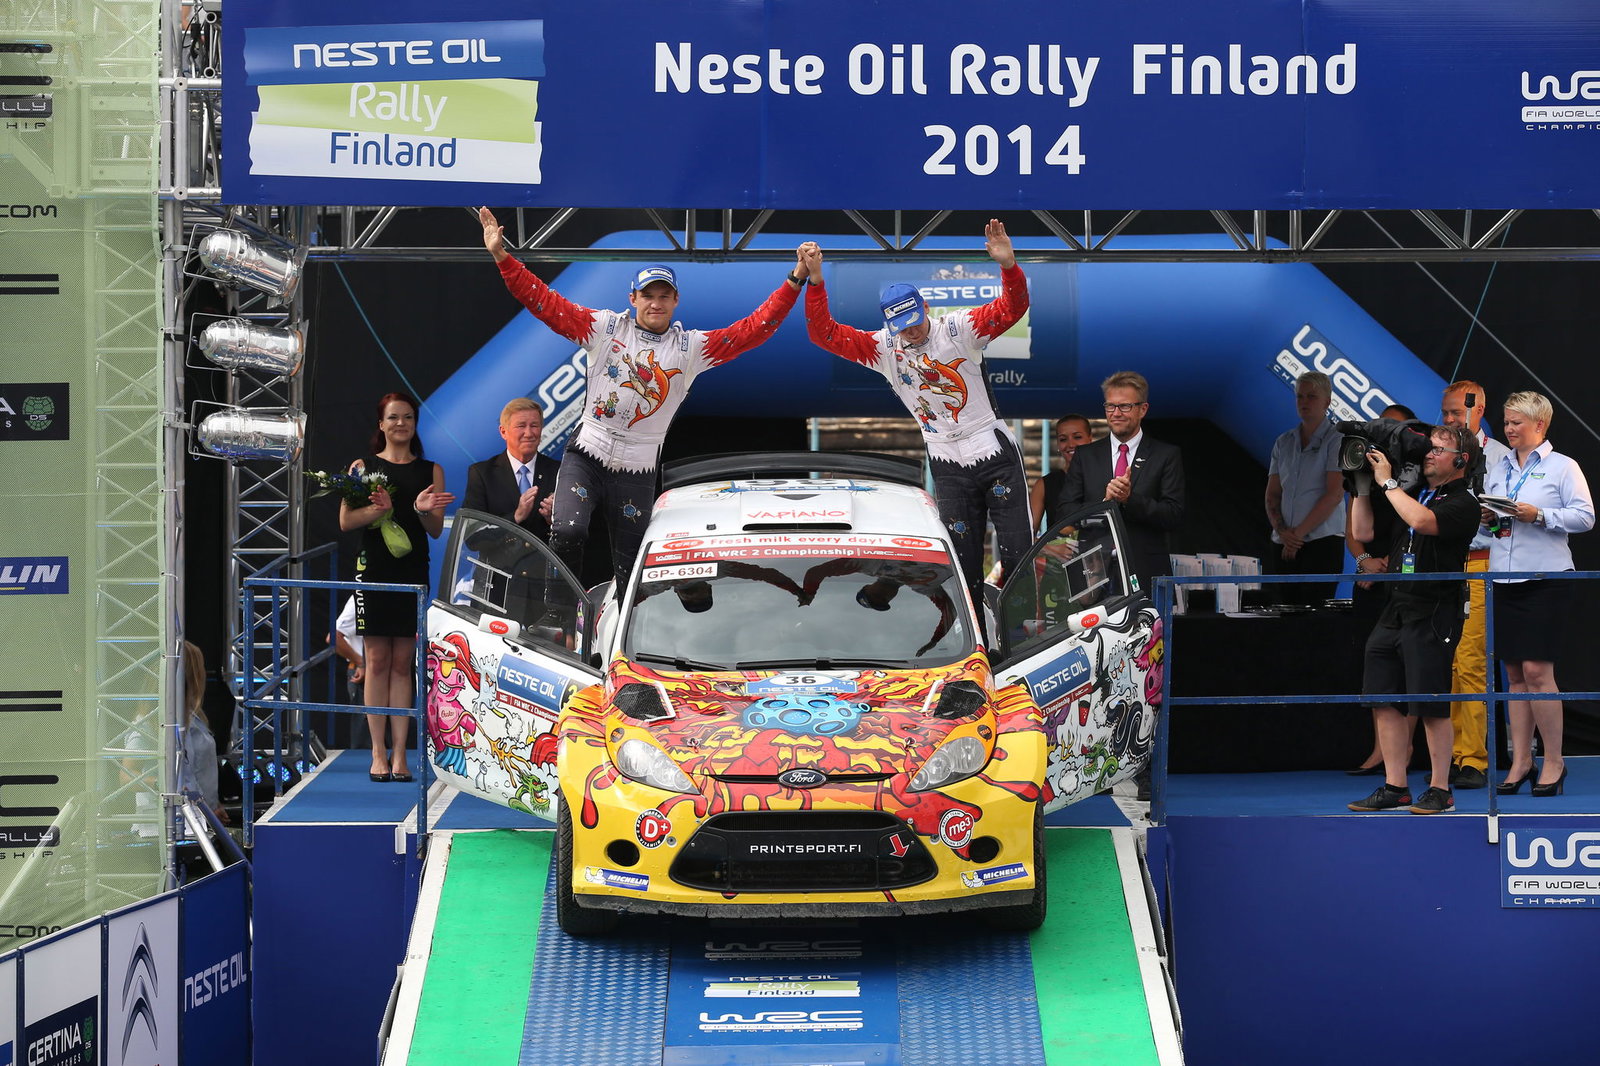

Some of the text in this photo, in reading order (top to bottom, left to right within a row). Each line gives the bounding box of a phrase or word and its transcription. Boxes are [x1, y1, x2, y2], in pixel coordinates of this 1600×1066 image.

[293, 38, 502, 68] NESTE OIL
[654, 41, 1357, 108] Neste Oil Rally Finland
[349, 82, 448, 132] Rally
[1526, 110, 1548, 118] FIA
[329, 131, 457, 168] Finland
[922, 123, 1087, 176] 2014
[710, 537, 752, 545] Fresh
[798, 536, 841, 544] every
[848, 536, 882, 545] day!
[694, 551, 715, 559] FIA
[718, 549, 749, 557] WRC
[751, 548, 760, 556] 2
[763, 548, 855, 557] Championship
[499, 665, 557, 700] NESTE OIL
[785, 675, 817, 685] 36
[1033, 660, 1088, 698] NESTE OIL
[790, 771, 816, 783] Ford
[749, 844, 862, 854] PRINTSPORT.FI
[983, 866, 1025, 880] MICHELIN
[608, 874, 649, 886] MICHELIN
[1513, 880, 1600, 889] FIA WORL
[183, 951, 248, 1013] NESTE OIL
[757, 982, 811, 990] Rally
[699, 1010, 864, 1023] WRC
[27, 1022, 82, 1066] CERTINA
